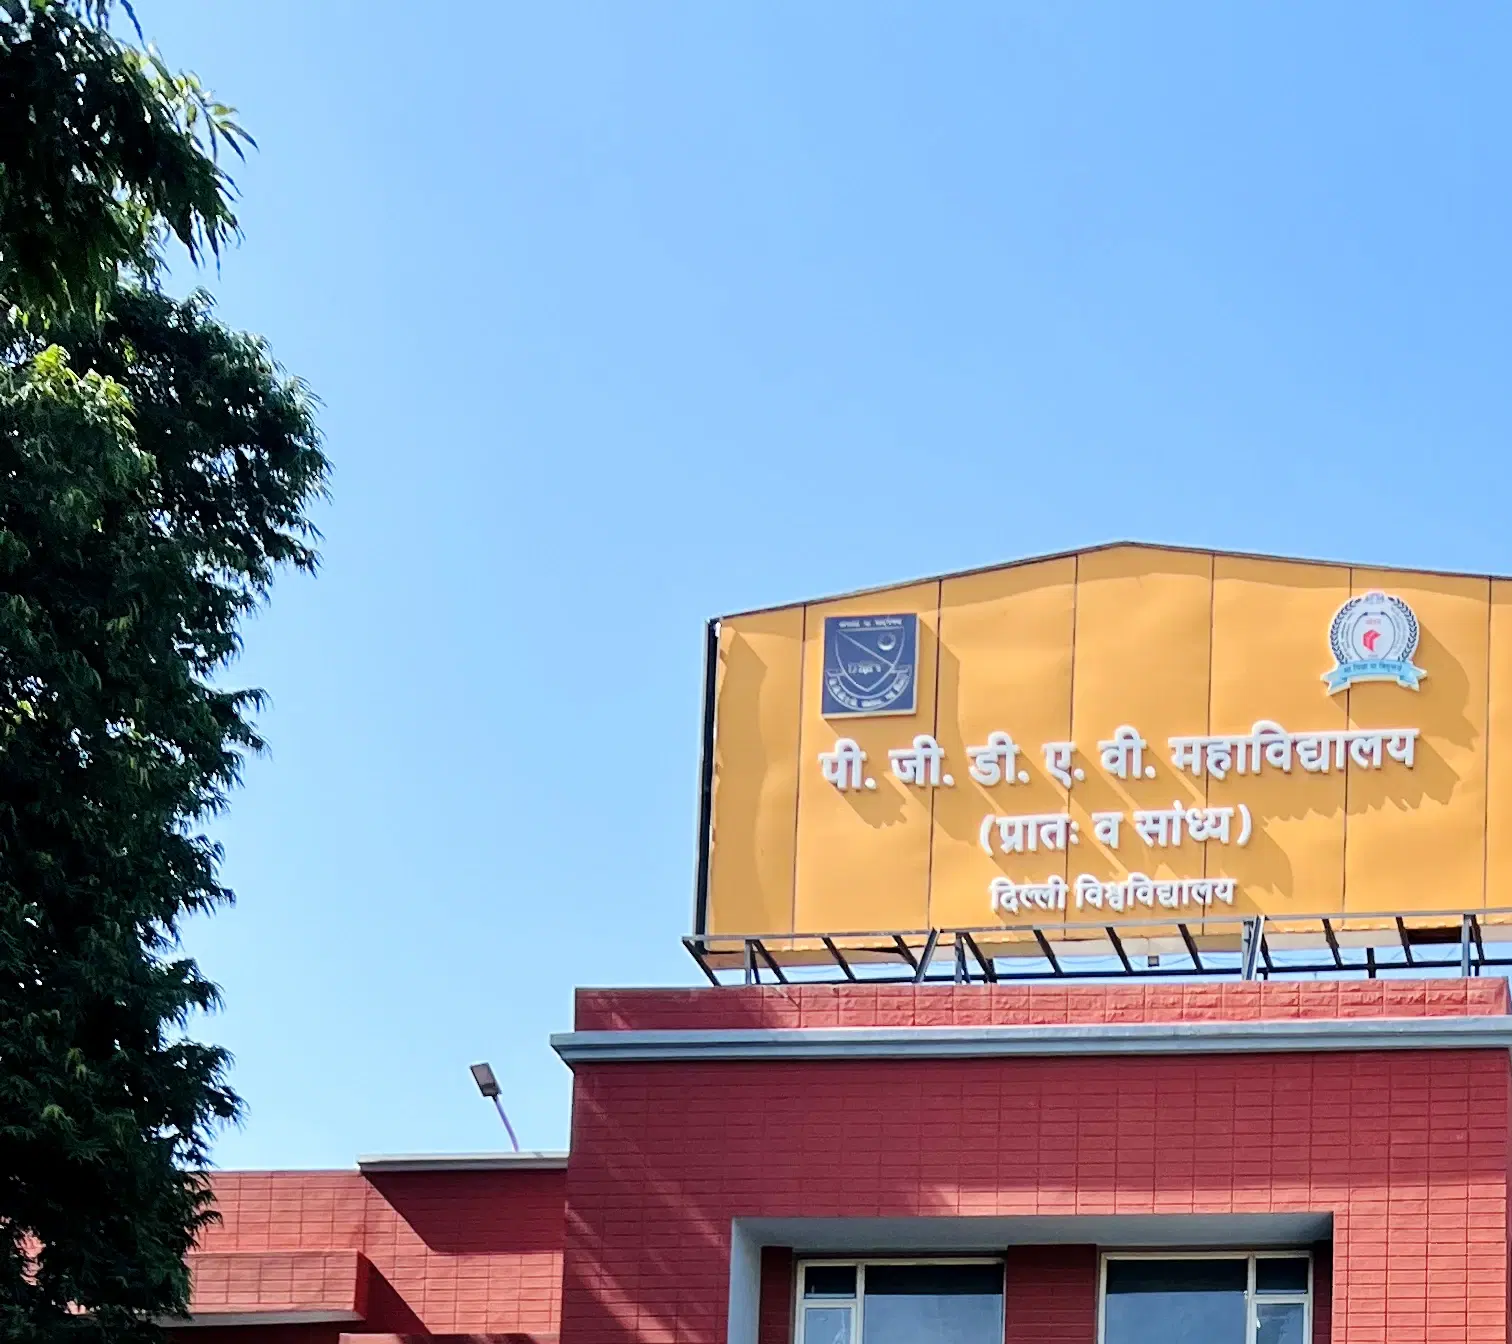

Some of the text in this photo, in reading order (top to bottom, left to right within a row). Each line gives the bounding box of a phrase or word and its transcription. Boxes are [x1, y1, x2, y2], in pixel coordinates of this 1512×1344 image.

[819, 719, 1420, 791] पी. जी. डी. ए. वी. महाविद्यालय
[1092, 811, 1123, 849] व
[989, 872, 1237, 914] दिल्ली विश्वविद्यालय
